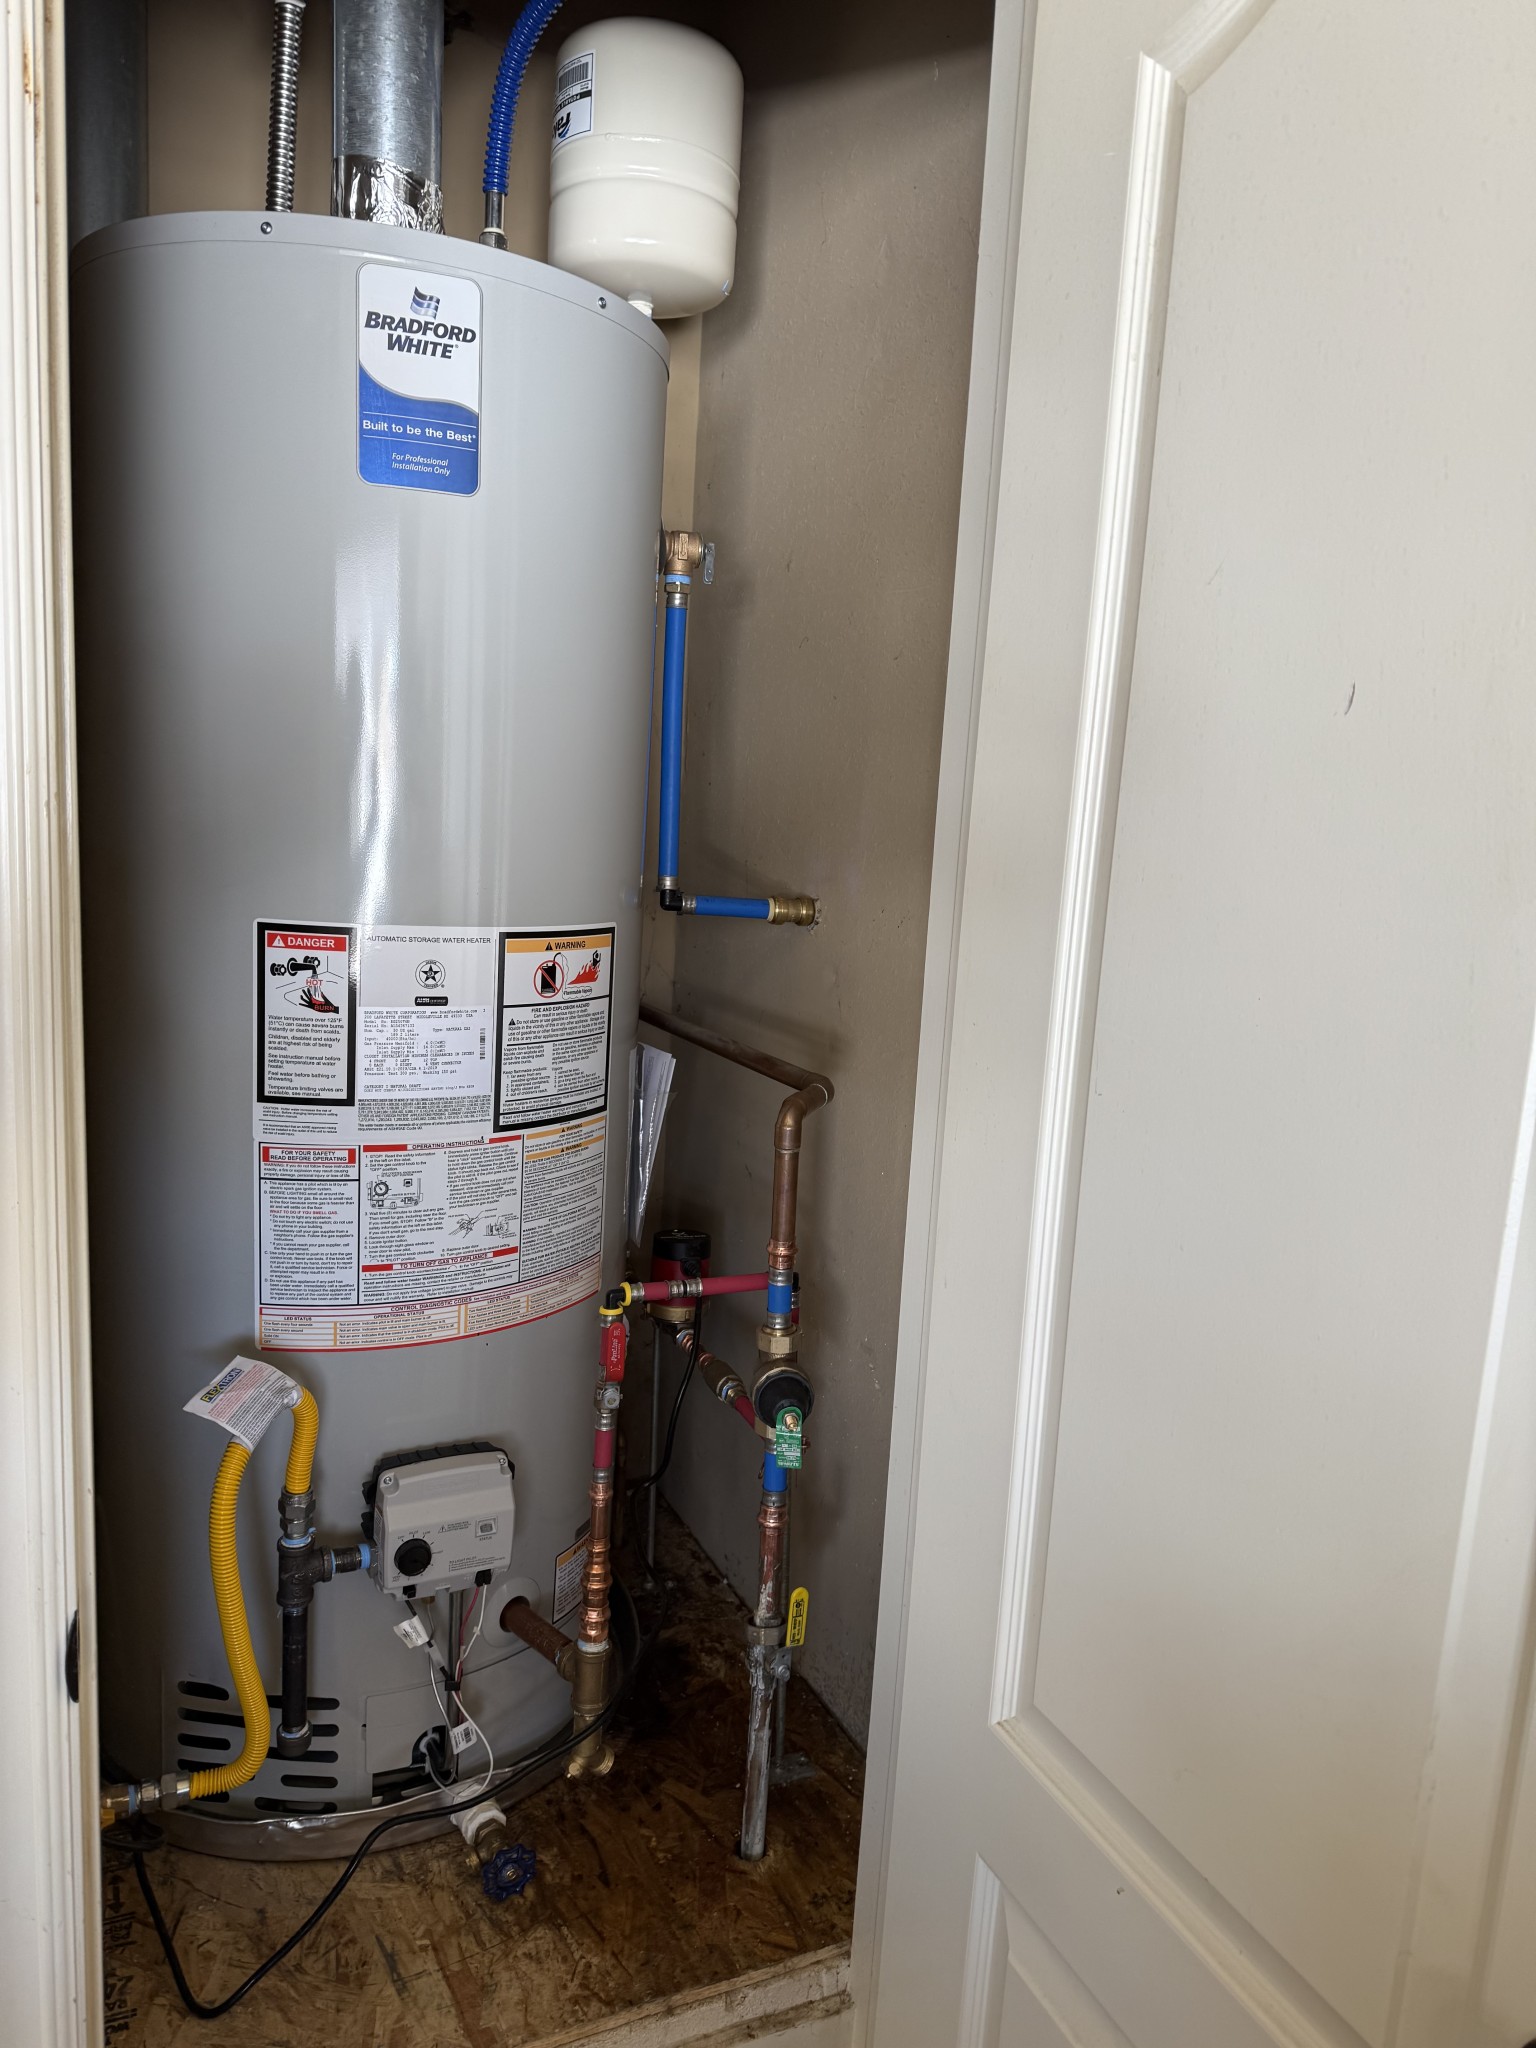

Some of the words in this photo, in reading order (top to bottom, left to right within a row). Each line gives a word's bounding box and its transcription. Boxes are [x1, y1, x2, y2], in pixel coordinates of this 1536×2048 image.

[364, 311, 477, 344] BRADFORD
[387, 332, 454, 359] WHITE
[363, 420, 389, 432] Built
[392, 422, 403, 433] to
[407, 422, 422, 435] be
[425, 425, 443, 438] the
[405, 453, 448, 466] Professional
[392, 462, 433, 473] Installation
[434, 467, 451, 476] Only
[288, 937, 335, 948] DANGER
[555, 941, 586, 949] WARNING
[420, 1301, 453, 1309] DIAGNOSTIC
